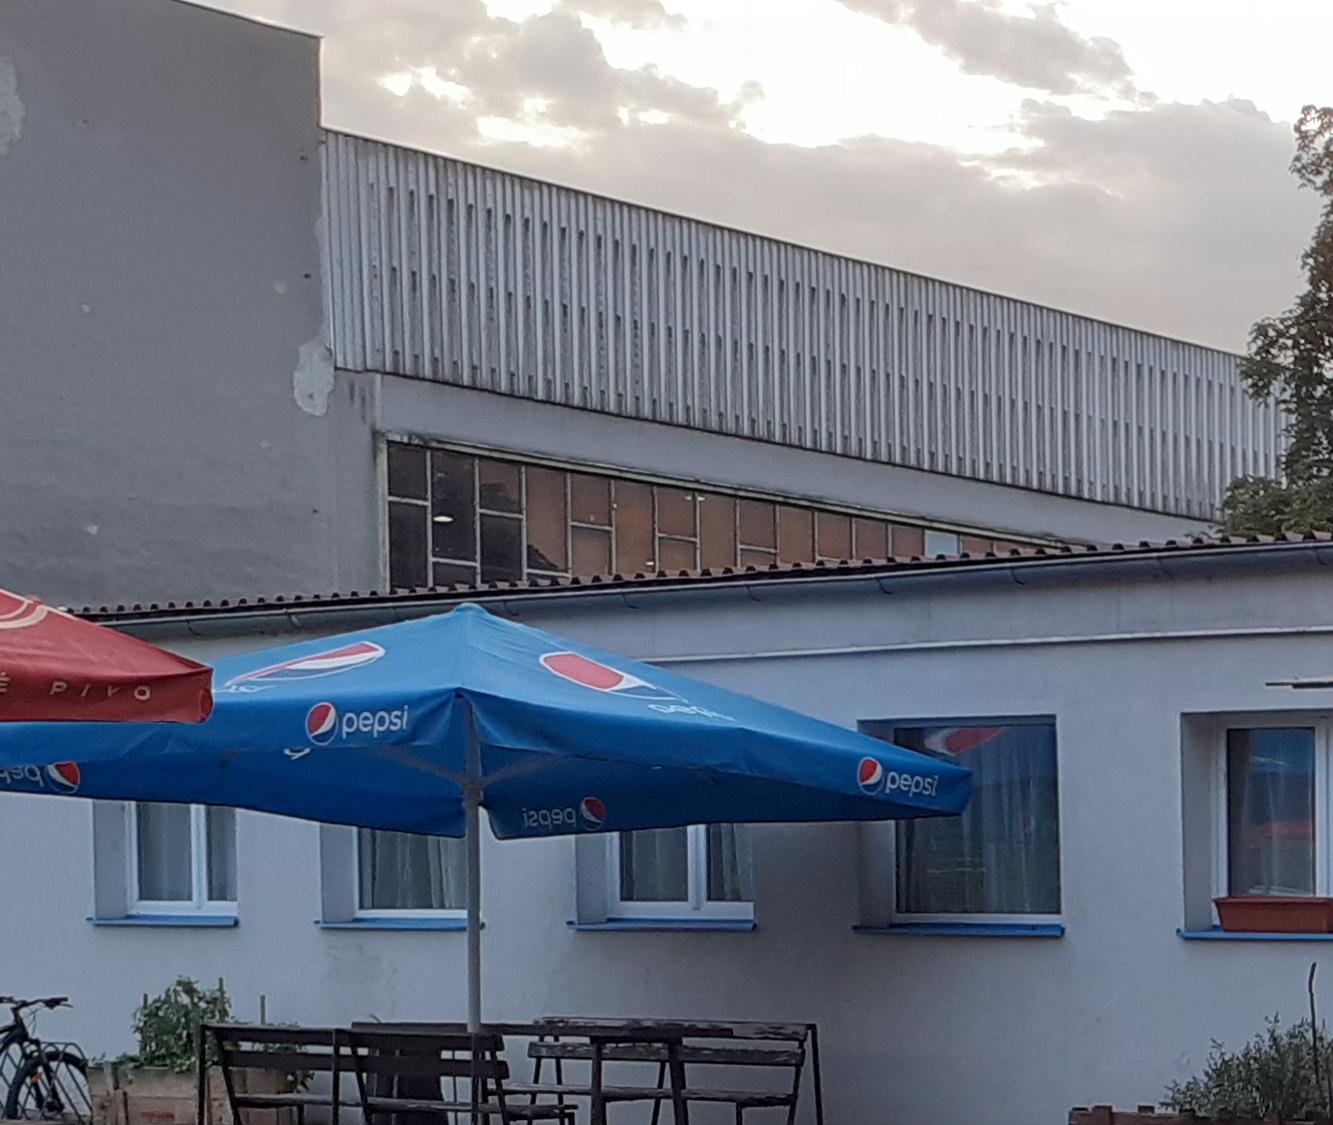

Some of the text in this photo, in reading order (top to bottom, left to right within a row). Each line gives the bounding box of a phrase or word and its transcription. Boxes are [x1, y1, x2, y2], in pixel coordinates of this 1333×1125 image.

[50, 680, 151, 701] PIVO
[342, 704, 410, 740] pepsi
[884, 770, 940, 798] pepsi
